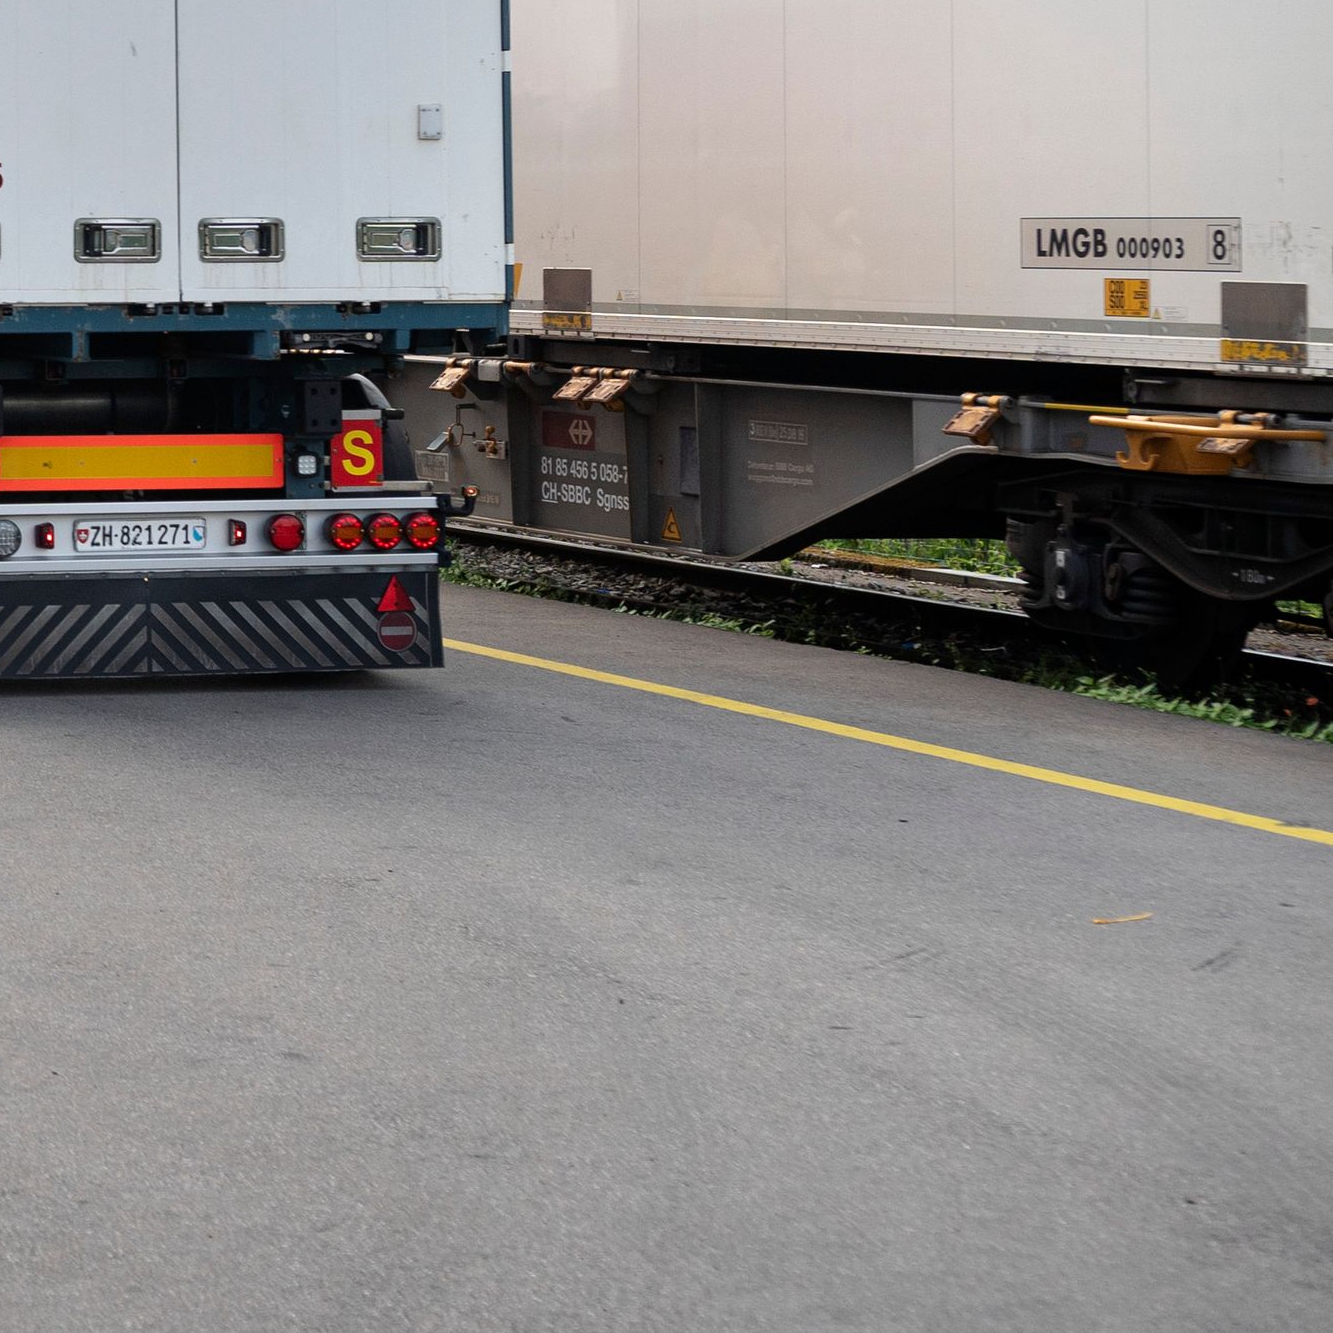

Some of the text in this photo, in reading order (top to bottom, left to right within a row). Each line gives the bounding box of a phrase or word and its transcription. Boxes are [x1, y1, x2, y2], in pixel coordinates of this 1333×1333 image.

[1036, 227, 1227, 260] LMGB 000903 8
[341, 429, 375, 476] S
[541, 456, 553, 475] 81
[555, 458, 568, 477] 85
[570, 460, 589, 479] 456
[590, 462, 598, 481] 5
[541, 481, 630, 513] CH-SBBC Sgnss
